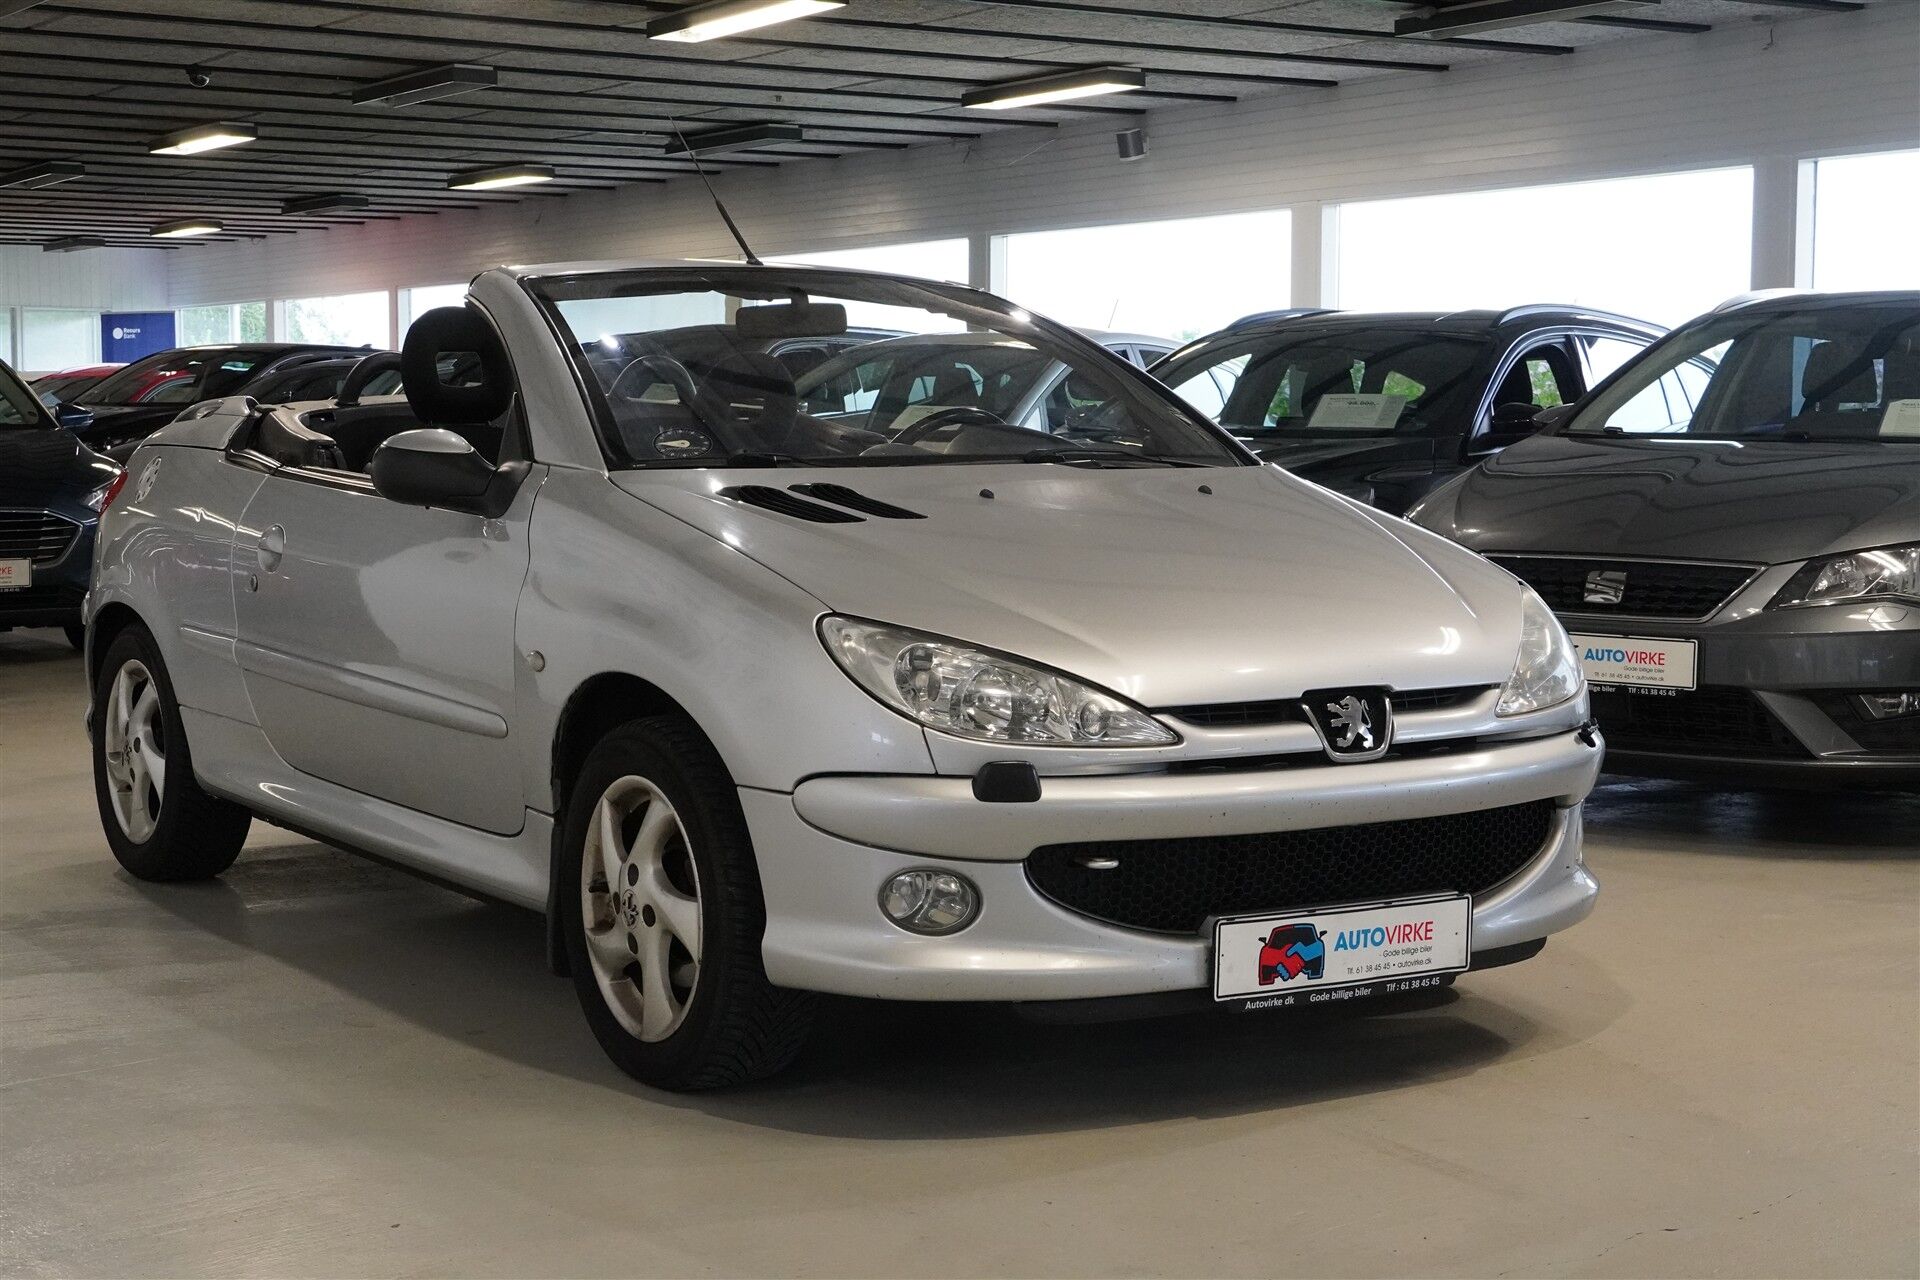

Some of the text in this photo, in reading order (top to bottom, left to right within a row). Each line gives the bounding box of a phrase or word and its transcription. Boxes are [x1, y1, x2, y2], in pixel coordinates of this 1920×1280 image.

[1584, 648, 1665, 666] AUTOVIRKE
[1334, 921, 1433, 951] AUTOVIRKE
[1382, 945, 1433, 958] Gode billige biler
[1356, 966, 1363, 974] 61
[1365, 964, 1373, 973] 38
[1374, 963, 1382, 972] 45
[1383, 962, 1391, 970] 45
[1397, 958, 1432, 969] autovirke.dk
[1400, 982, 1410, 990] 61
[1411, 980, 1420, 989] 38
[1421, 978, 1430, 987] 45
[1431, 977, 1440, 985] 45
[1310, 987, 1372, 1002] Gode billige biler
[1245, 996, 1295, 1010] Autovirke dk
